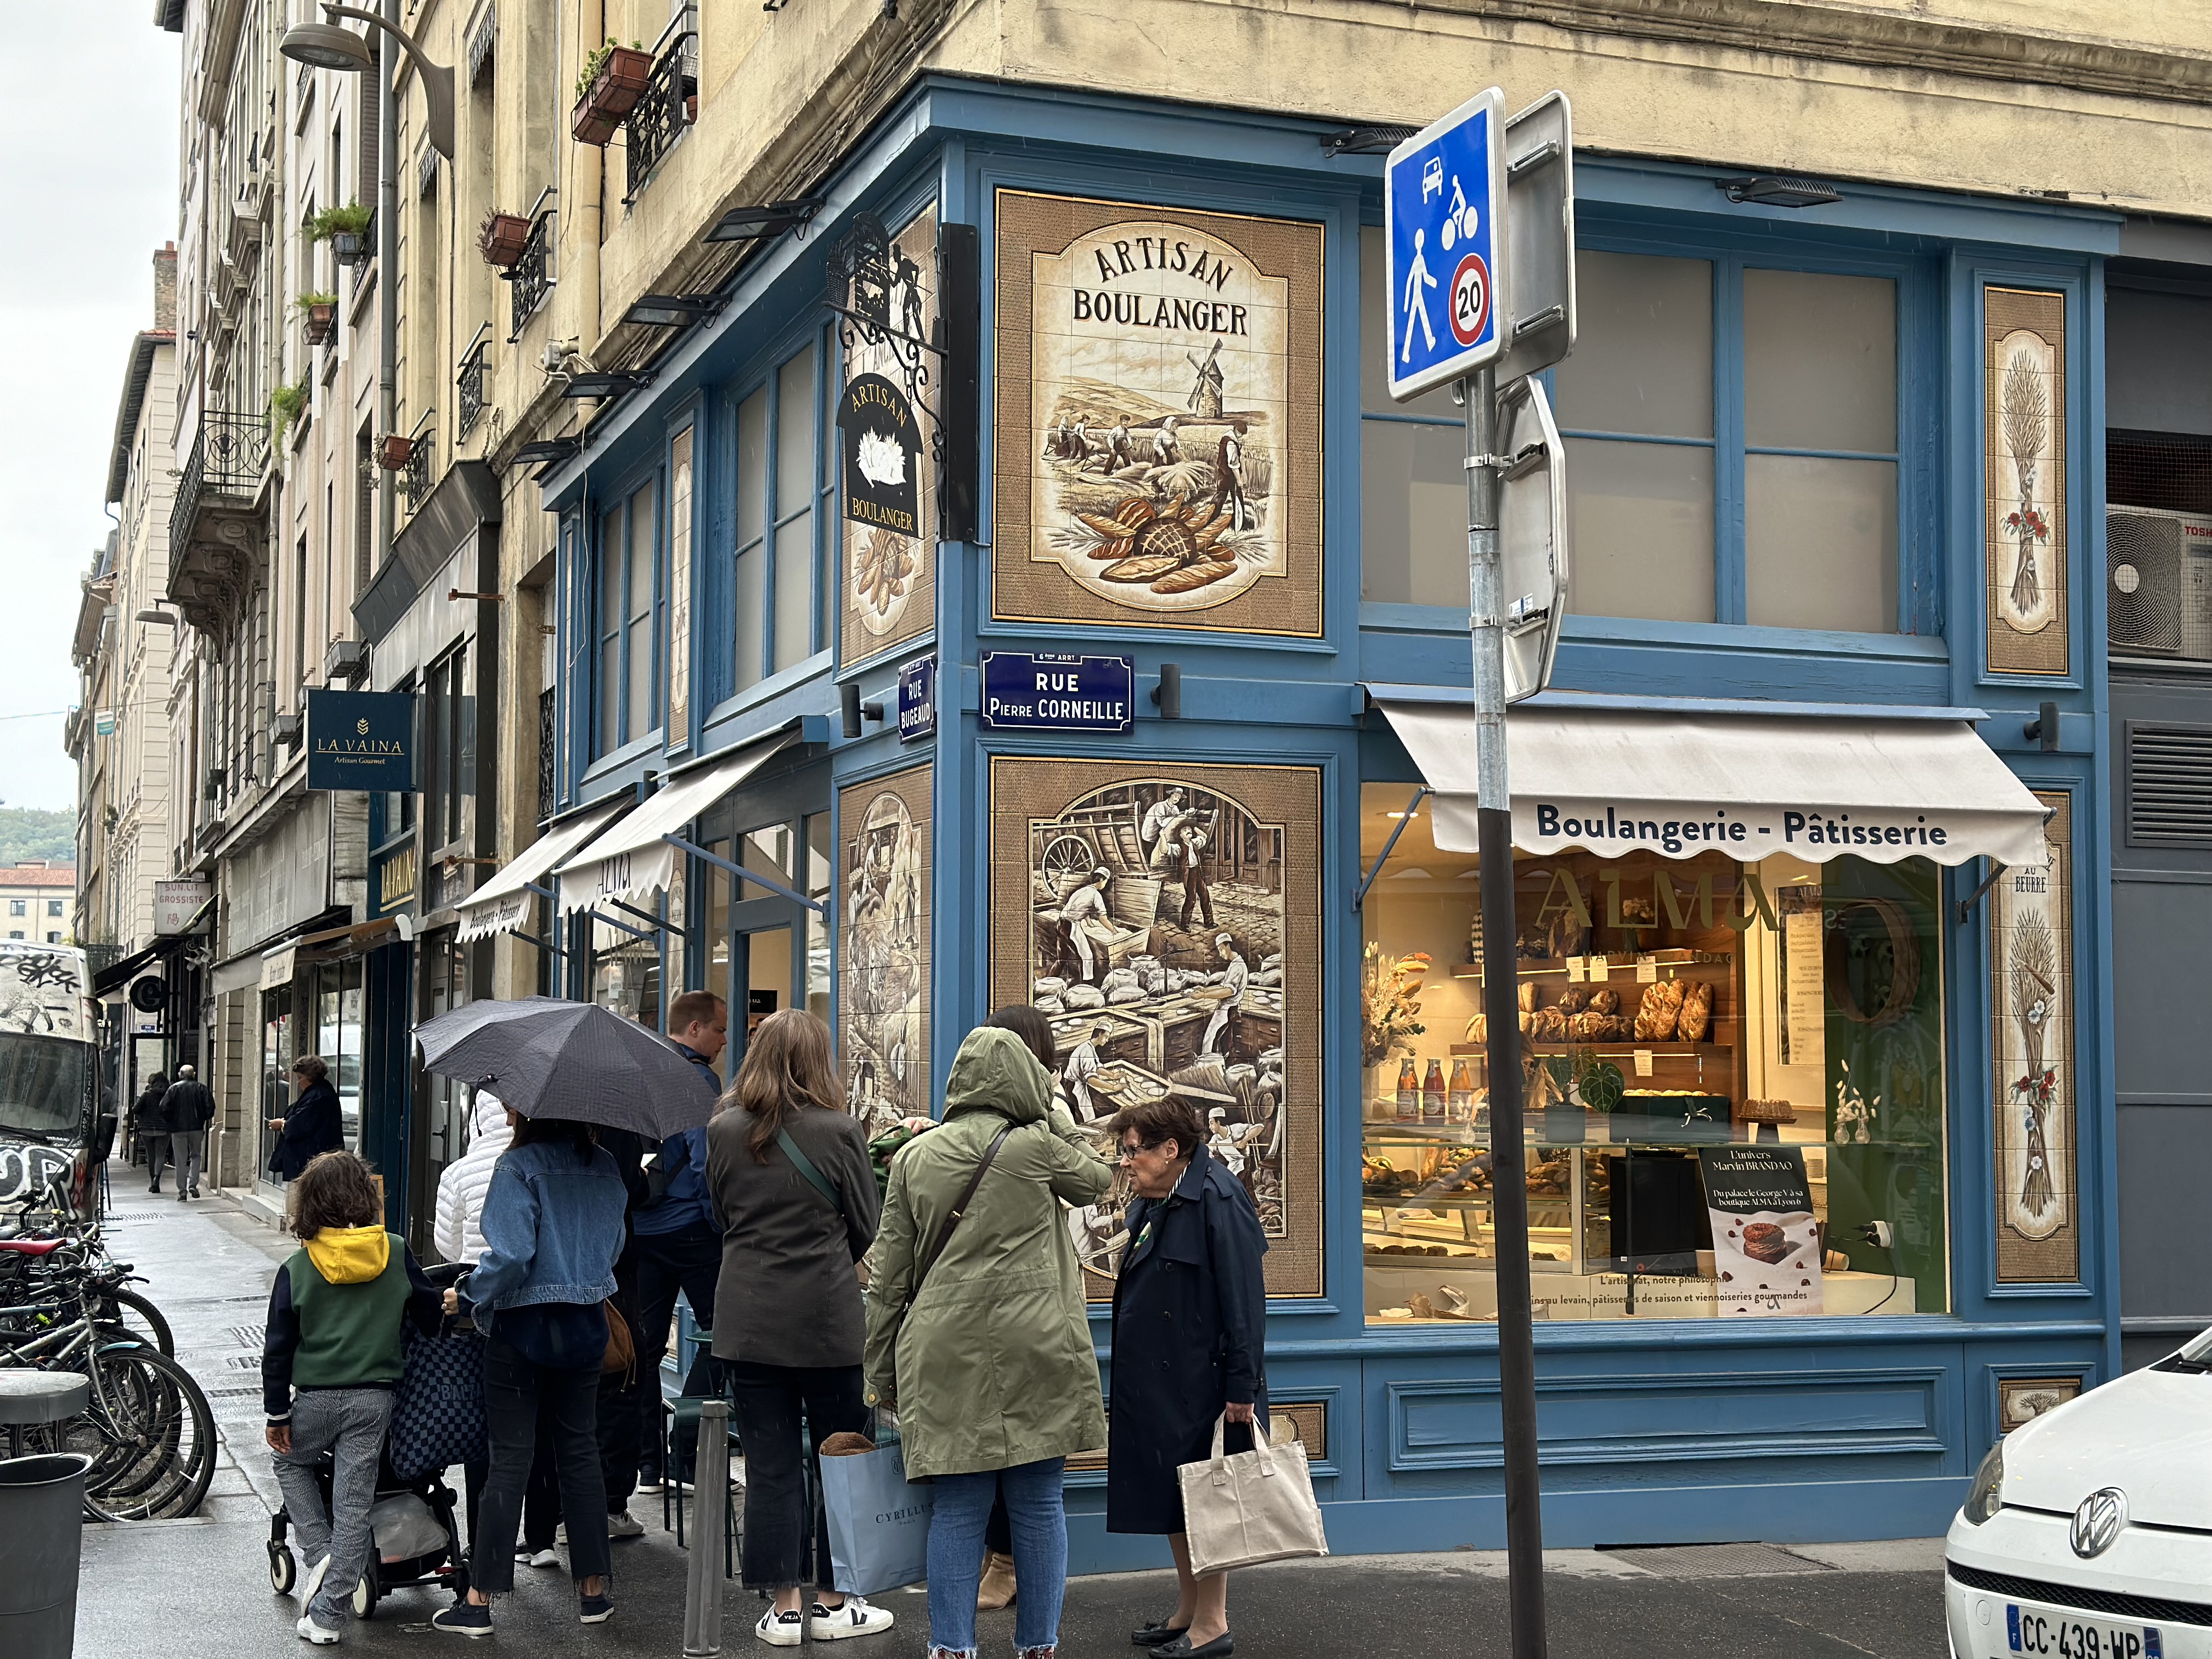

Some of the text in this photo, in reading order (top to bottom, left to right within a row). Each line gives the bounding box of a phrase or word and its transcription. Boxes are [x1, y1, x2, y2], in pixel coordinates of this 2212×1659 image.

[1094, 237, 1233, 294] ARTISAN
[1458, 280, 1481, 320] 20
[1073, 289, 1248, 337] BOULANGER
[852, 383, 907, 427] ARTISAN
[852, 497, 913, 531] BOULANGER
[909, 679, 922, 701] RUE
[1036, 673, 1079, 692] RUE
[901, 702, 930, 730] BUGEAUD
[1038, 699, 1124, 720] CORNEILLE
[318, 738, 402, 753] LA VAINA
[1537, 804, 1747, 853] Boulangerie
[1784, 811, 1948, 845] Pâtisserie
[392, 846, 415, 899] VAIN
[2015, 876, 2046, 893] BEURRE
[159, 895, 204, 904] GROSSISTE
[1536, 867, 1780, 932] ALMA
[1583, 950, 1733, 964] MARVIN ANDAO
[1730, 1150, 1771, 1160] L'univers
[1712, 1161, 1793, 1171] Marvin BRANDAO
[1718, 1198, 1750, 1207] boutique
[1778, 1198, 1796, 1207] Lyon
[1725, 1189, 1748, 1199] palace
[1749, 1189, 1756, 1197] le
[1756, 1189, 1782, 1199] George
[1652, 1276, 1676, 1284] notre
[1560, 1294, 1590, 1307] levain,
[1642, 1293, 1651, 1303] de
[1655, 1293, 1682, 1302] saison
[1684, 1294, 1693, 1302] et
[1695, 1291, 1752, 1301] viennoiseries
[1755, 1290, 1807, 1304] gourmandes
[876, 1502, 934, 1524] CYRILLUS
[2012, 1633, 2016, 1643] F
